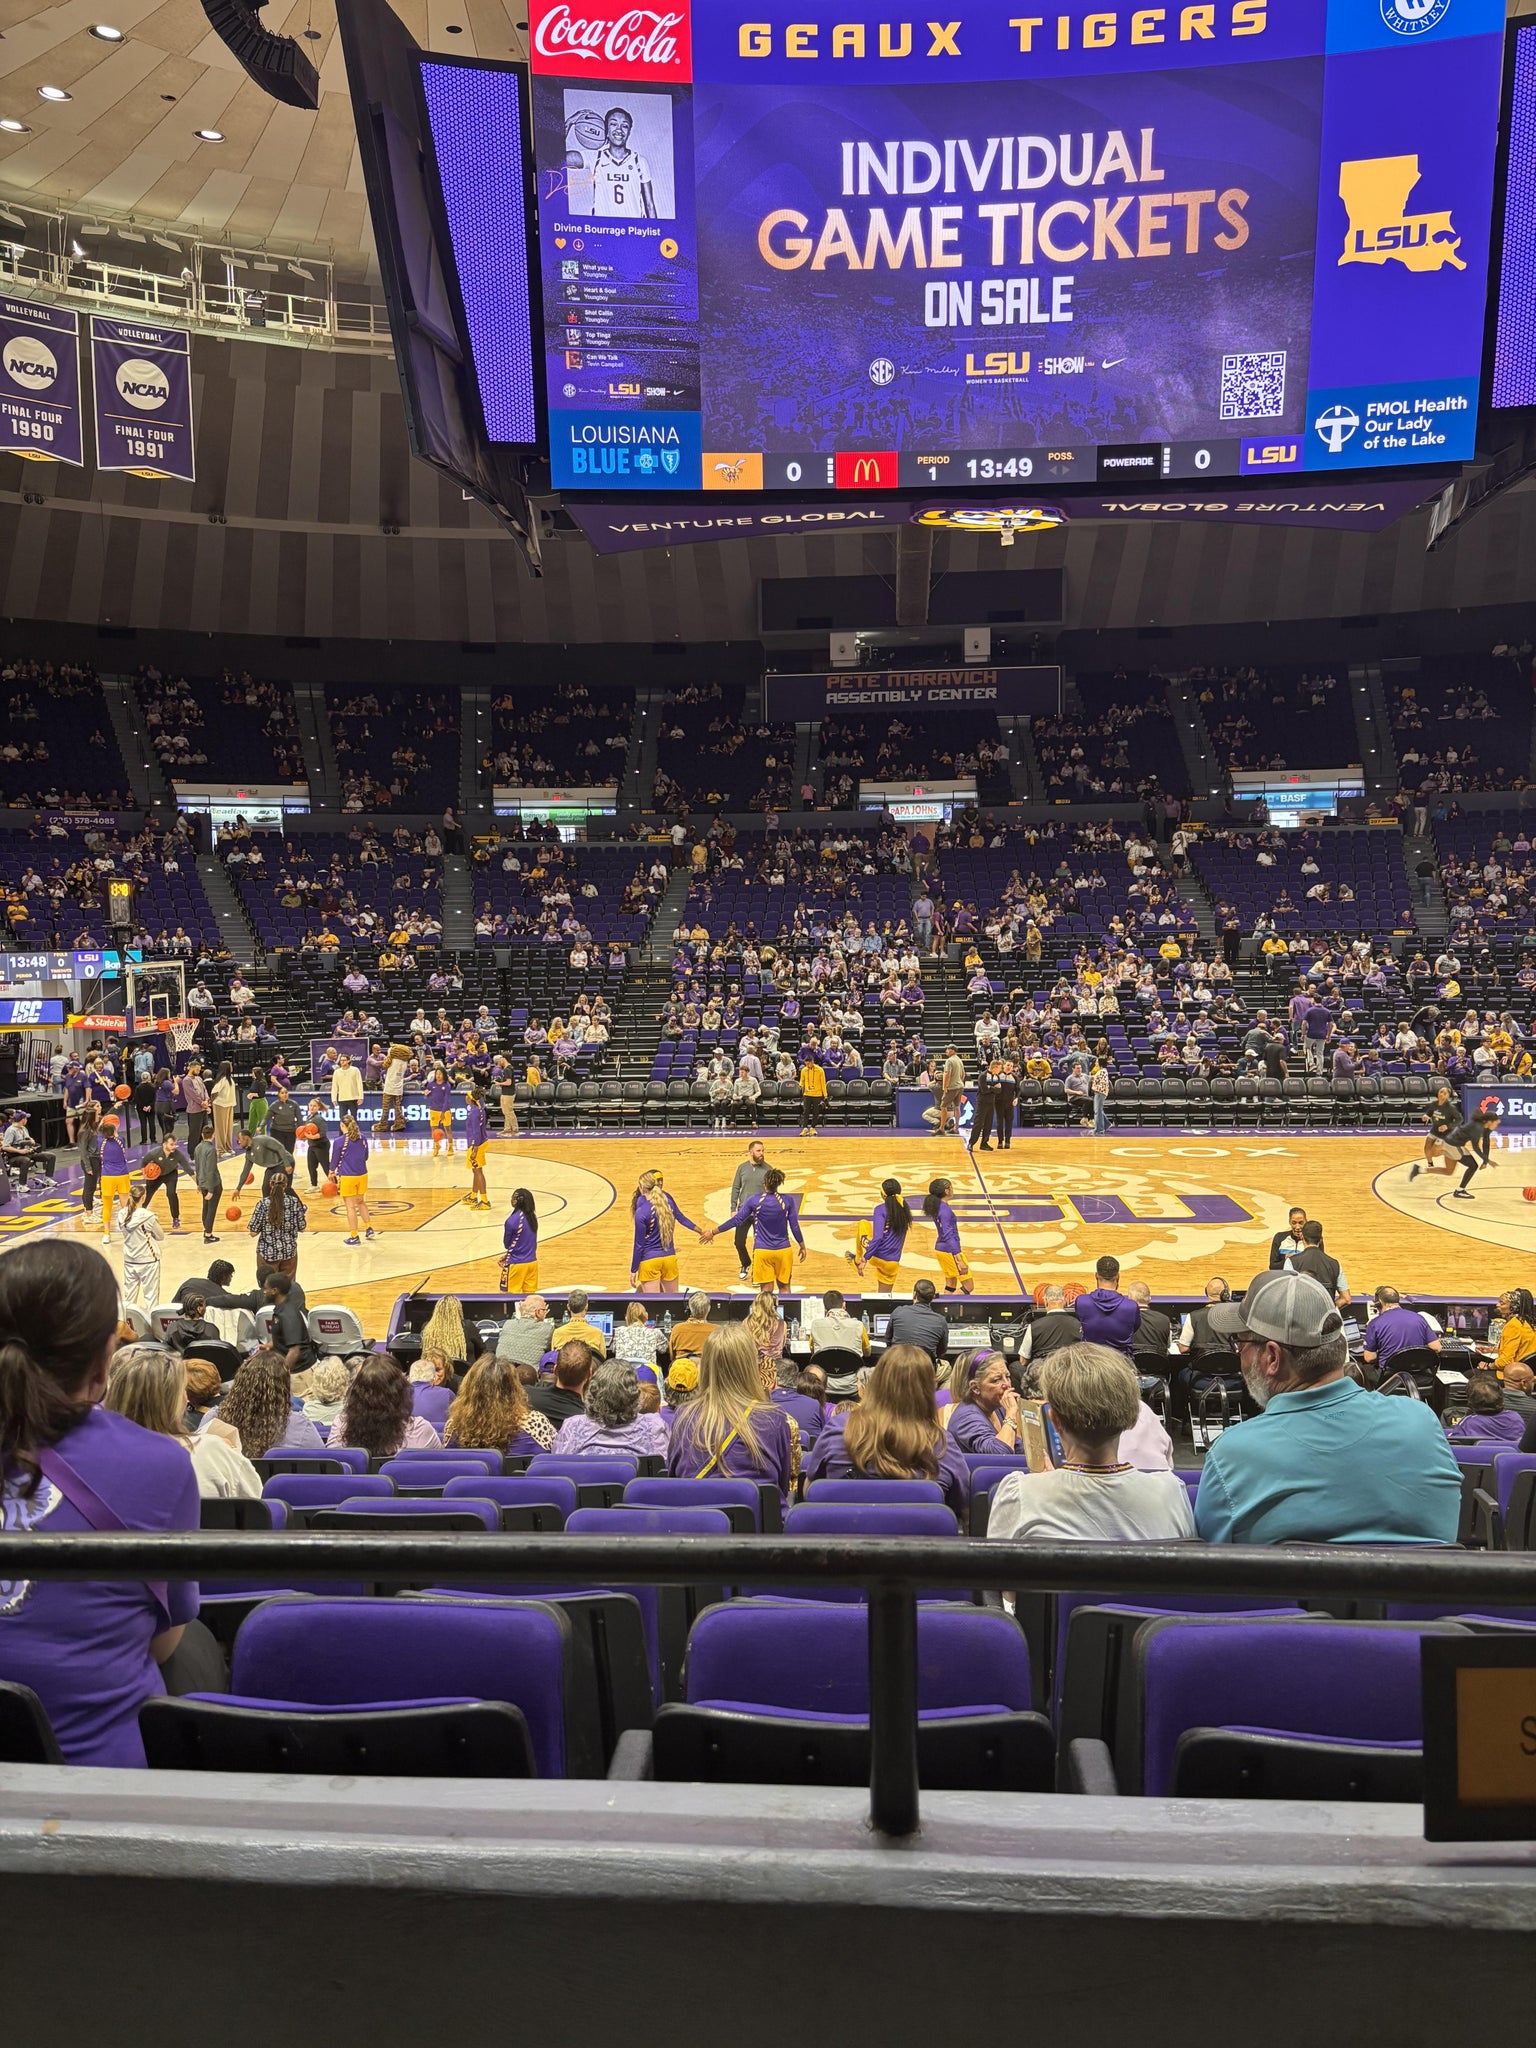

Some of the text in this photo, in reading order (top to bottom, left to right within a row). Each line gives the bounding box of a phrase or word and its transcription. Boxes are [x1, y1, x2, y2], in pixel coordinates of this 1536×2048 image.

[1385, 0, 1444, 31] WHITNEY
[534, 4, 686, 64] Coca-Cola
[738, 0, 1268, 58] GEAUX TIGERS
[840, 127, 1166, 196] INDIVIDUAL
[606, 172, 630, 182] LSU
[613, 184, 625, 205] 6
[554, 223, 661, 238] Divine Bourrage Playlist
[757, 188, 1251, 271] GAME TICKETS
[1354, 223, 1428, 253] LSU
[5, 303, 51, 320] VOLLEYBALL
[924, 276, 1075, 328] ON SALE
[118, 328, 163, 342] VOLLEYBALL
[9, 358, 57, 378] NCAA
[871, 365, 893, 384] SEC
[966, 352, 1030, 376] LSU
[1044, 357, 1085, 375] SHOW
[122, 381, 169, 398] NCAA
[609, 384, 640, 395] LSU
[2, 403, 63, 424] FINAL FOUR
[1366, 397, 1468, 417] FMOL Health
[11, 418, 54, 441] 1990
[115, 425, 174, 441] FINAL FOUR
[571, 424, 680, 445] LOUISIANA
[1364, 417, 1432, 433] Our Lady
[127, 439, 164, 459] 1991
[1363, 433, 1446, 449] of the Lake
[572, 448, 630, 475] BLUE
[917, 455, 950, 464] PERIOD
[1048, 452, 1075, 461] POSS.
[1103, 456, 1154, 468] POWERADE
[1194, 449, 1211, 470] 0
[1246, 445, 1298, 465] LSU
[786, 461, 802, 482] 0
[928, 467, 938, 481] 1
[966, 458, 1033, 480] 13:49
[608, 509, 886, 533] VENTURE GLOBAL
[826, 671, 998, 689] PETE MARAVICH
[825, 687, 998, 705] ASSEMBLY CENTER
[1280, 794, 1307, 803] BASF
[890, 806, 911, 816] PAPA
[10, 956, 47, 968] 13:48
[58, 958, 65, 967] 0
[78, 954, 99, 962] LSU
[84, 965, 95, 978] 0
[11, 1001, 43, 1023] ISC
[1110, 1147, 1300, 1157] COX
